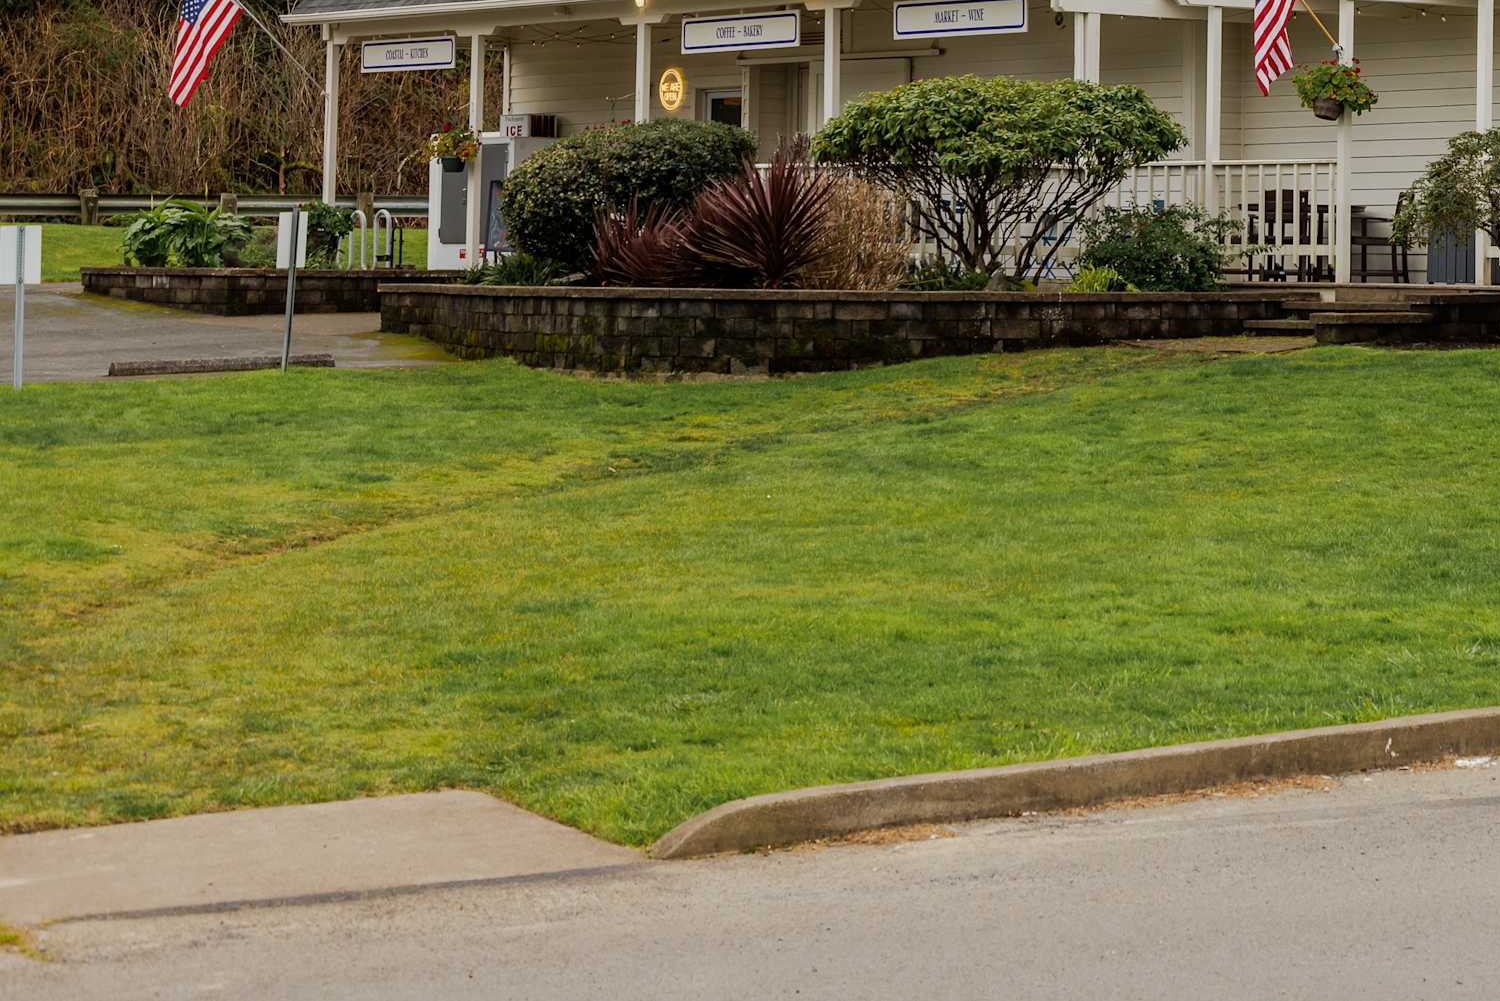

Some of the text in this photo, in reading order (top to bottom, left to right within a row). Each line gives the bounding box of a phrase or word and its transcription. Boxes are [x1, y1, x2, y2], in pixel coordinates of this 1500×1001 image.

[933, 9, 959, 24] MARKET
[968, 8, 984, 21] WINE
[715, 26, 736, 39] COFFEE
[743, 24, 763, 37] BAKERY
[506, 125, 522, 137] ICE
